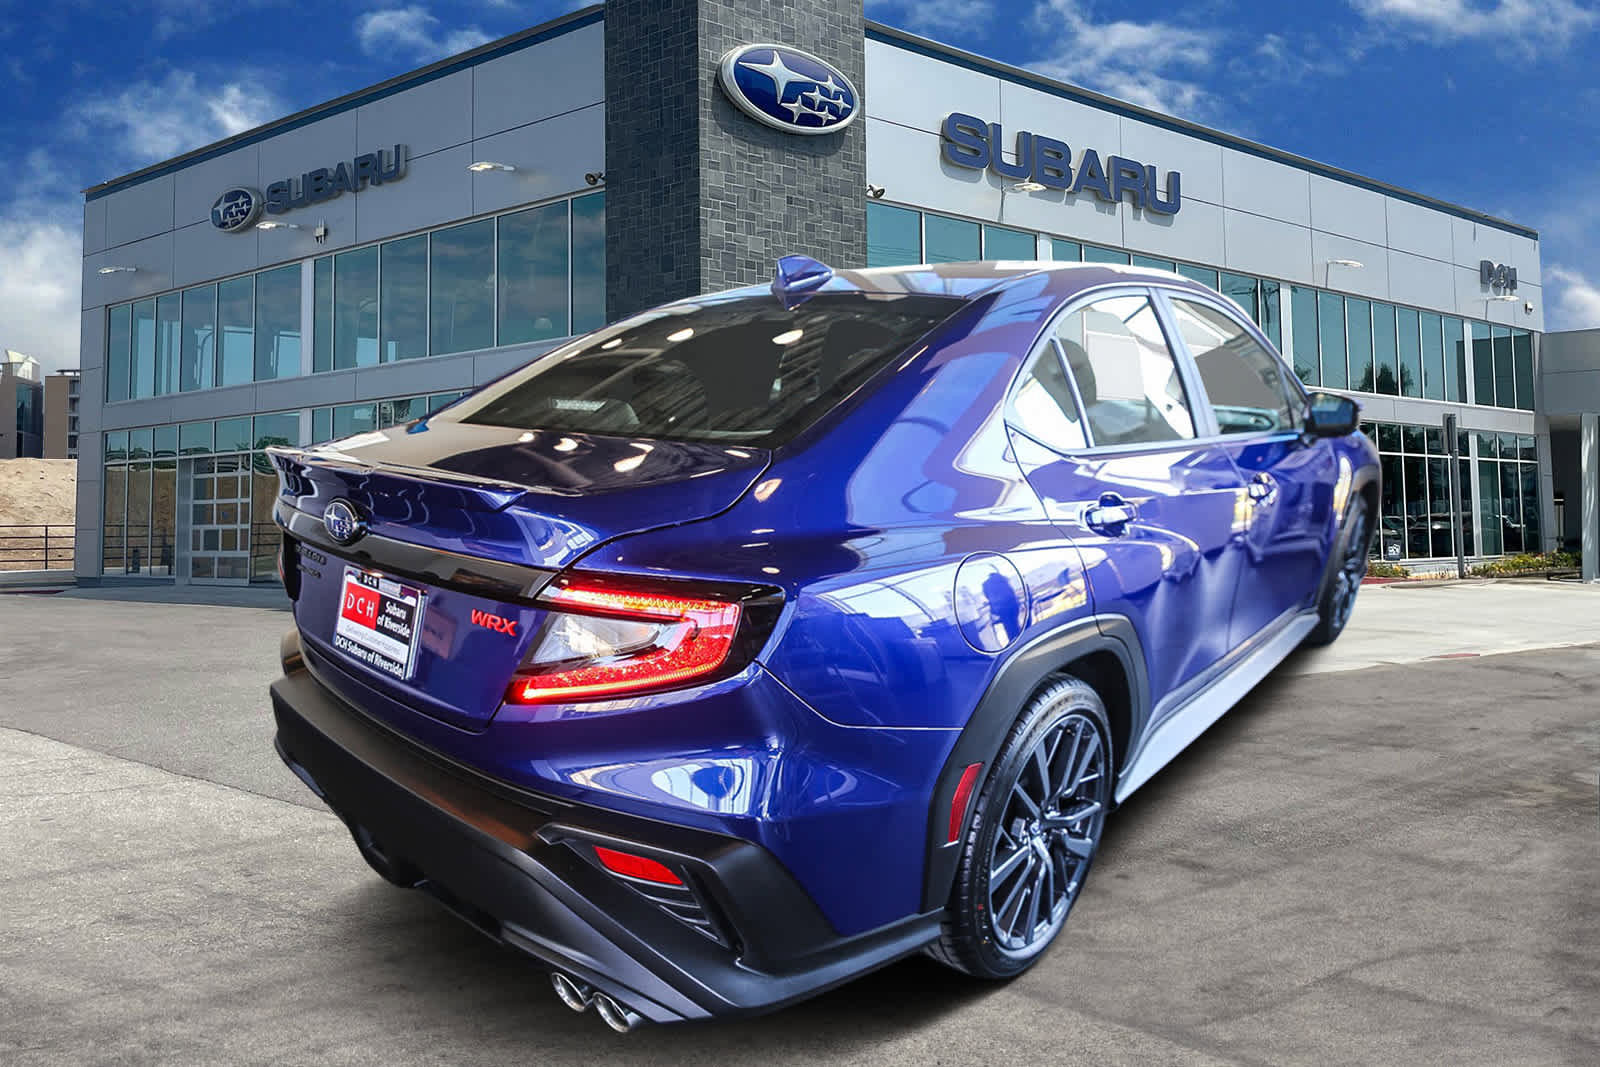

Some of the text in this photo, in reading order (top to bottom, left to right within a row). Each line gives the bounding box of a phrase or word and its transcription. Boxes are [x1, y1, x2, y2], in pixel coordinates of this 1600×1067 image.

[940, 112, 1181, 215] SUBARU
[266, 144, 407, 215] SUBARU
[346, 592, 376, 619] DCH
[385, 601, 407, 620] Subaru
[376, 614, 411, 638] of Riverside
[471, 607, 519, 638] WRX
[335, 635, 348, 651] DCH
[347, 638, 368, 660] Subaru
[367, 651, 376, 664] of
